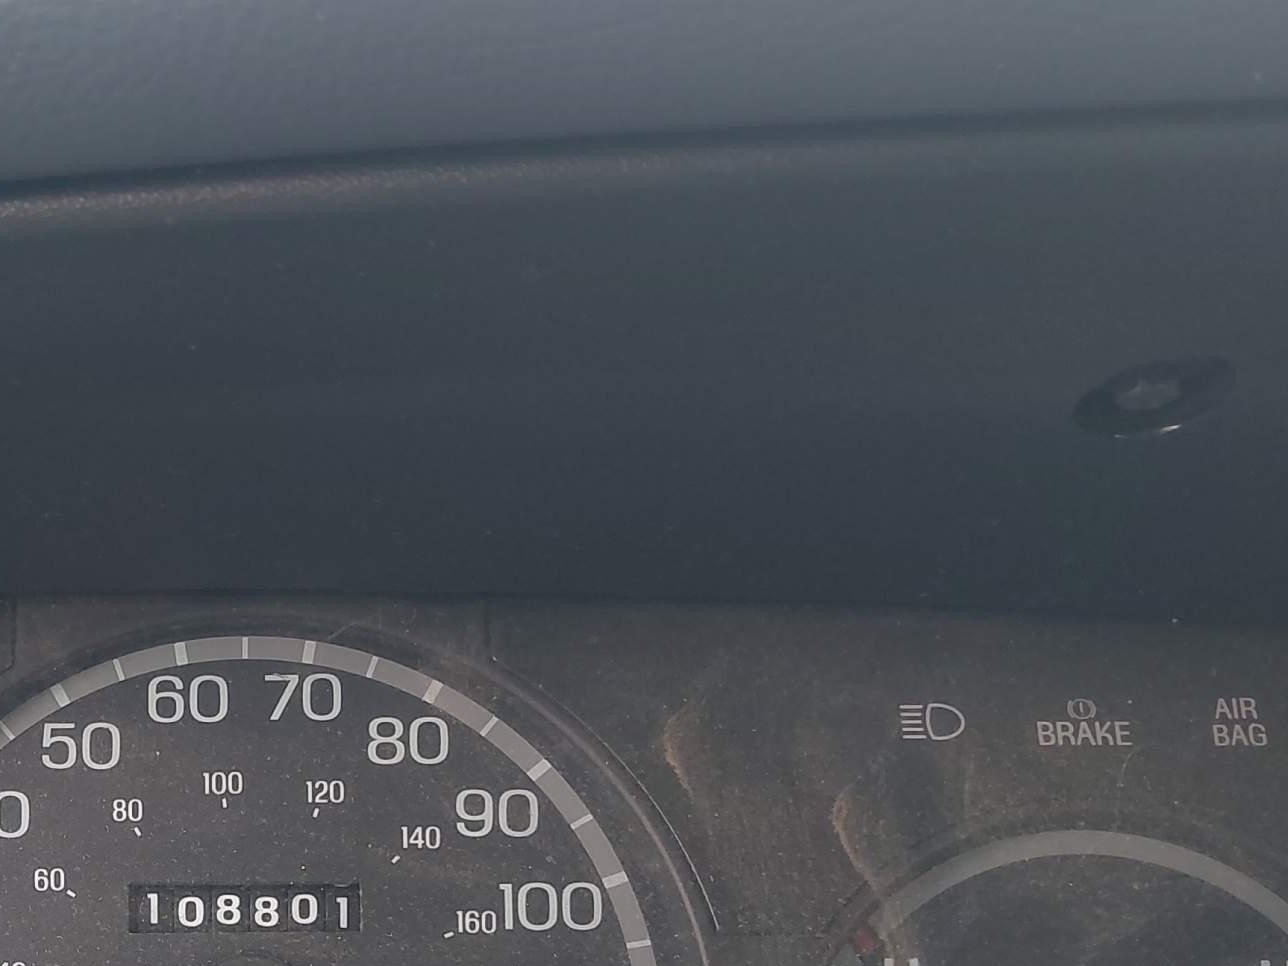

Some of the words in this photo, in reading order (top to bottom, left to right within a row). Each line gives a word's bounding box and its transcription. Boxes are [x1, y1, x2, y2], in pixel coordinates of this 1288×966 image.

[148, 675, 228, 723] 60
[265, 673, 341, 720] 70
[1215, 697, 1258, 720] AIR
[41, 722, 120, 769] 50
[367, 717, 449, 764] 80
[1037, 721, 1132, 746] BRAKE
[1213, 724, 1267, 746] BAG
[203, 771, 243, 794] 100
[306, 780, 345, 803] 120
[112, 799, 143, 821] 80
[455, 789, 539, 837] 90
[401, 826, 441, 849] 140
[34, 868, 65, 891] 60
[147, 893, 348, 929] 108801
[498, 882, 602, 930] 100
[456, 910, 497, 934] 160
